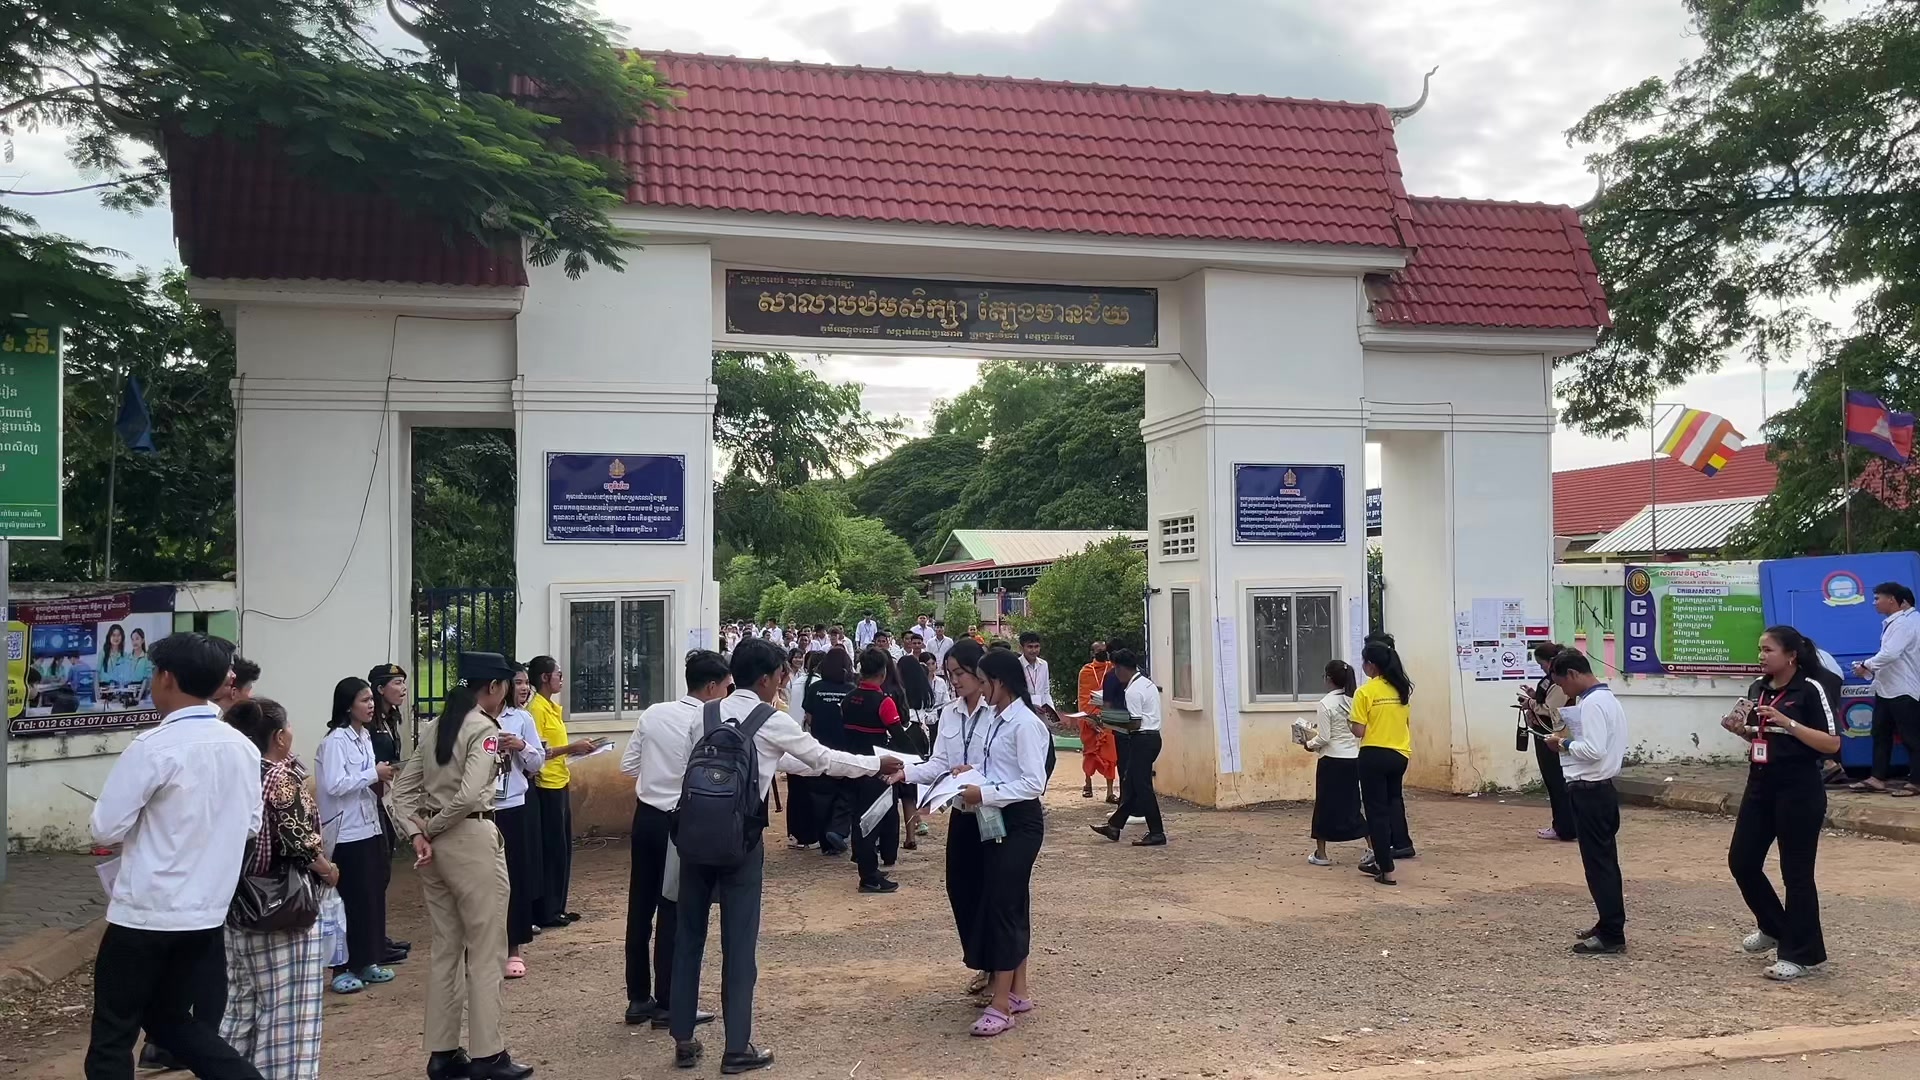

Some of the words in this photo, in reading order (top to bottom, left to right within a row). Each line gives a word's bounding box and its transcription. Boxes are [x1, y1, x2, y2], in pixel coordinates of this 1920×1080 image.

[758, 288, 969, 329] សាលាបឋមសិក្សា
[1630, 599, 1647, 661] CUS
[17, 721, 36, 730] Tel:
[38, 720, 57, 729] 012
[59, 718, 72, 727] 63
[73, 717, 86, 726] 62
[107, 715, 123, 724] 087
[125, 714, 138, 722] 63
[139, 713, 150, 721] 62
